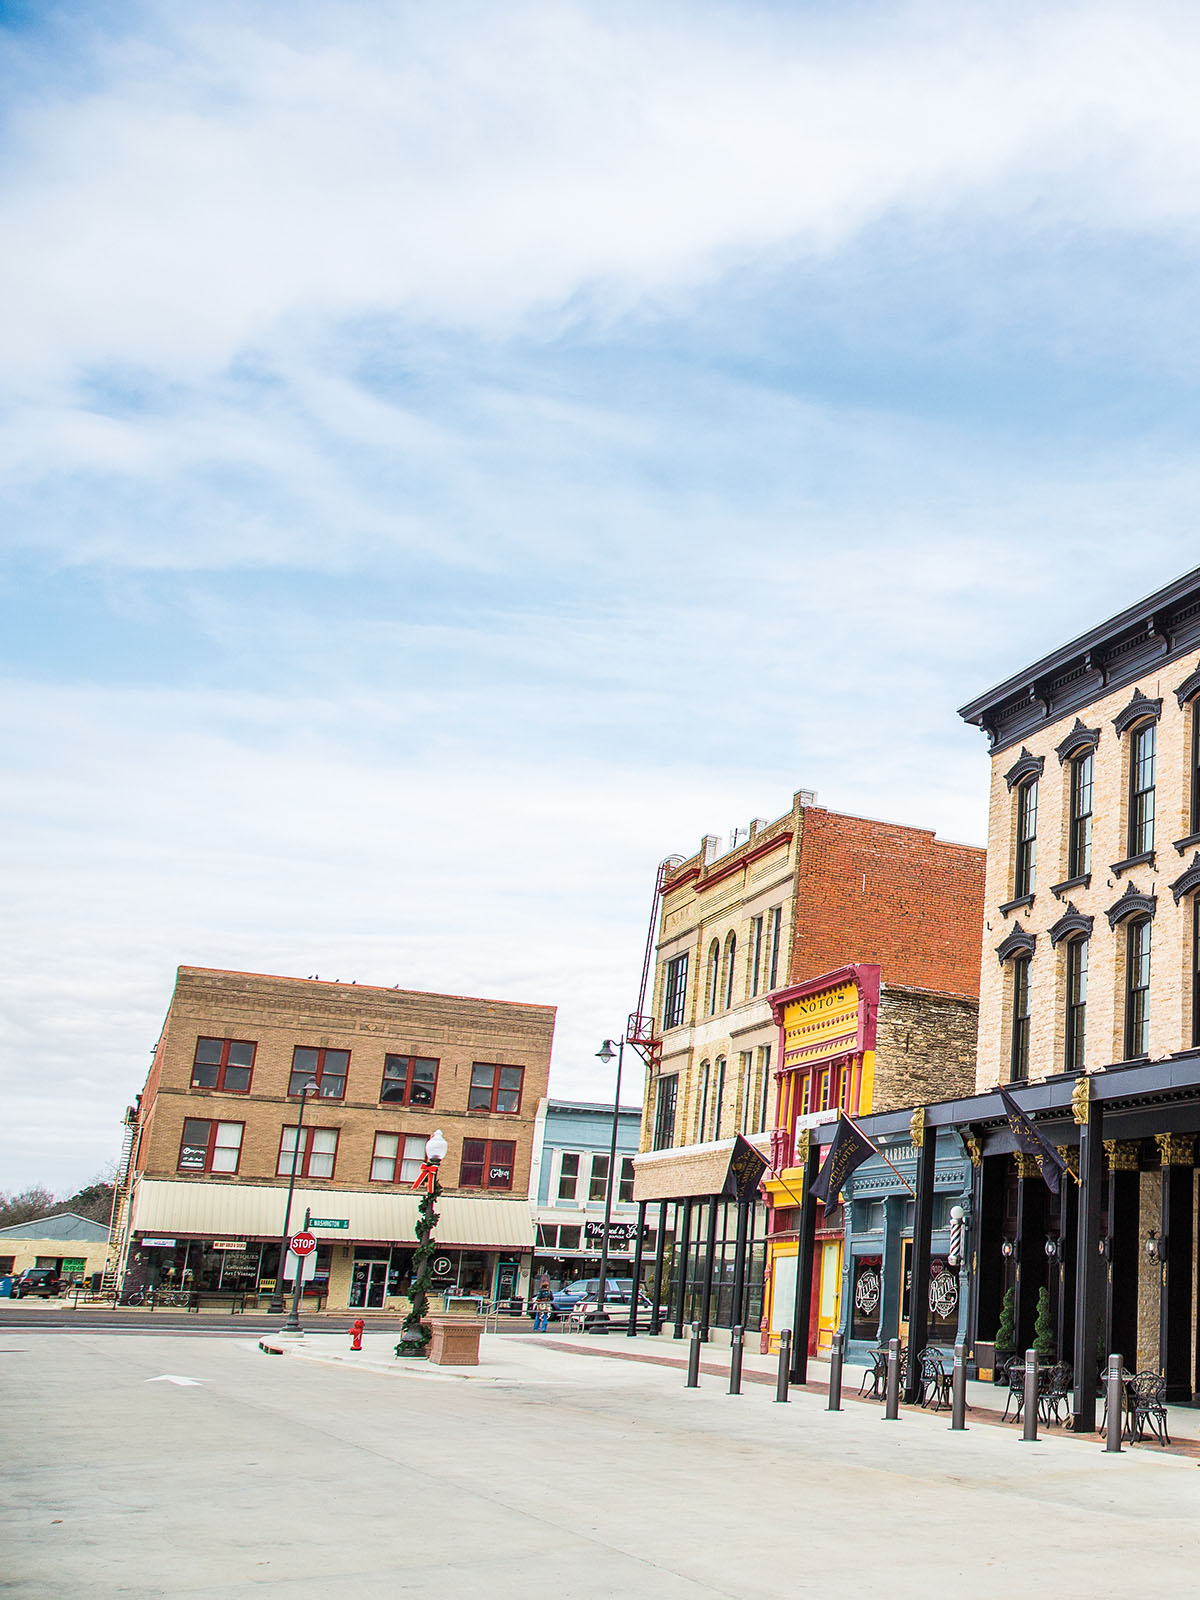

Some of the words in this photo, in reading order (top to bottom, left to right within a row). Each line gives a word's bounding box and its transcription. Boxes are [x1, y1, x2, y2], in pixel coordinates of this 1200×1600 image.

[800, 992, 844, 1015] NOTO'S
[838, 1142, 860, 1168] HOTEL
[885, 1146, 918, 1160] BARBERSH
[292, 1238, 314, 1248] STOP
